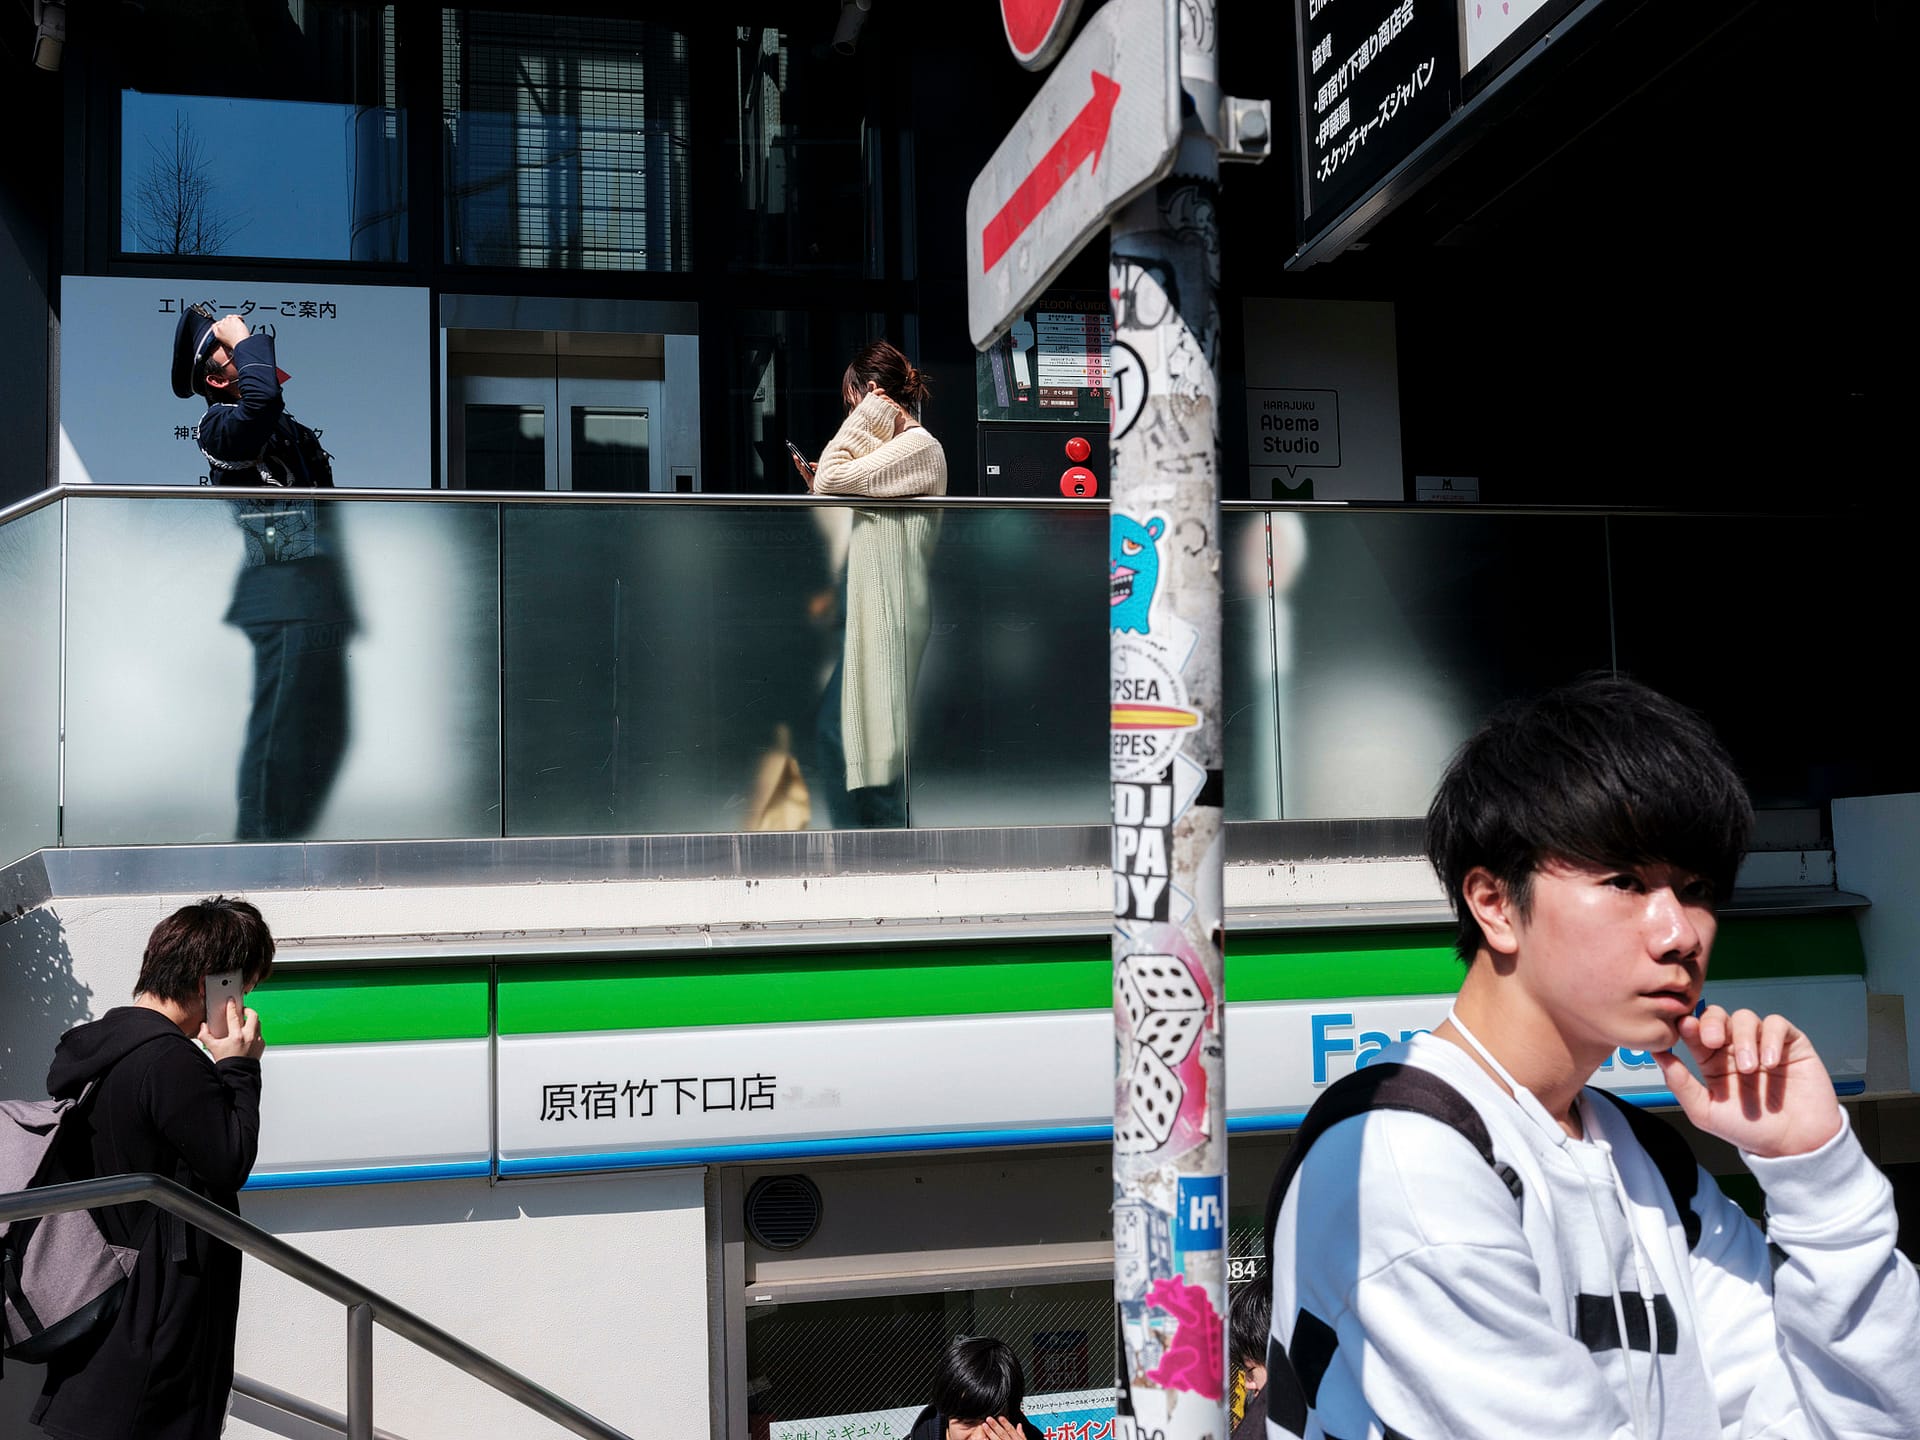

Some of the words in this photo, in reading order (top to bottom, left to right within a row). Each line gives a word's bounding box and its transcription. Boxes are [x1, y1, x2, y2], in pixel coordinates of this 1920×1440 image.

[1312, 33, 1332, 74] 協賛
[1263, 400, 1315, 411] HARAJUKU
[1260, 414, 1320, 432] Abema
[1263, 436, 1320, 454] Studio
[1114, 783, 1171, 827] DJ
[539, 1073, 777, 1122] 原宿竹下口店
